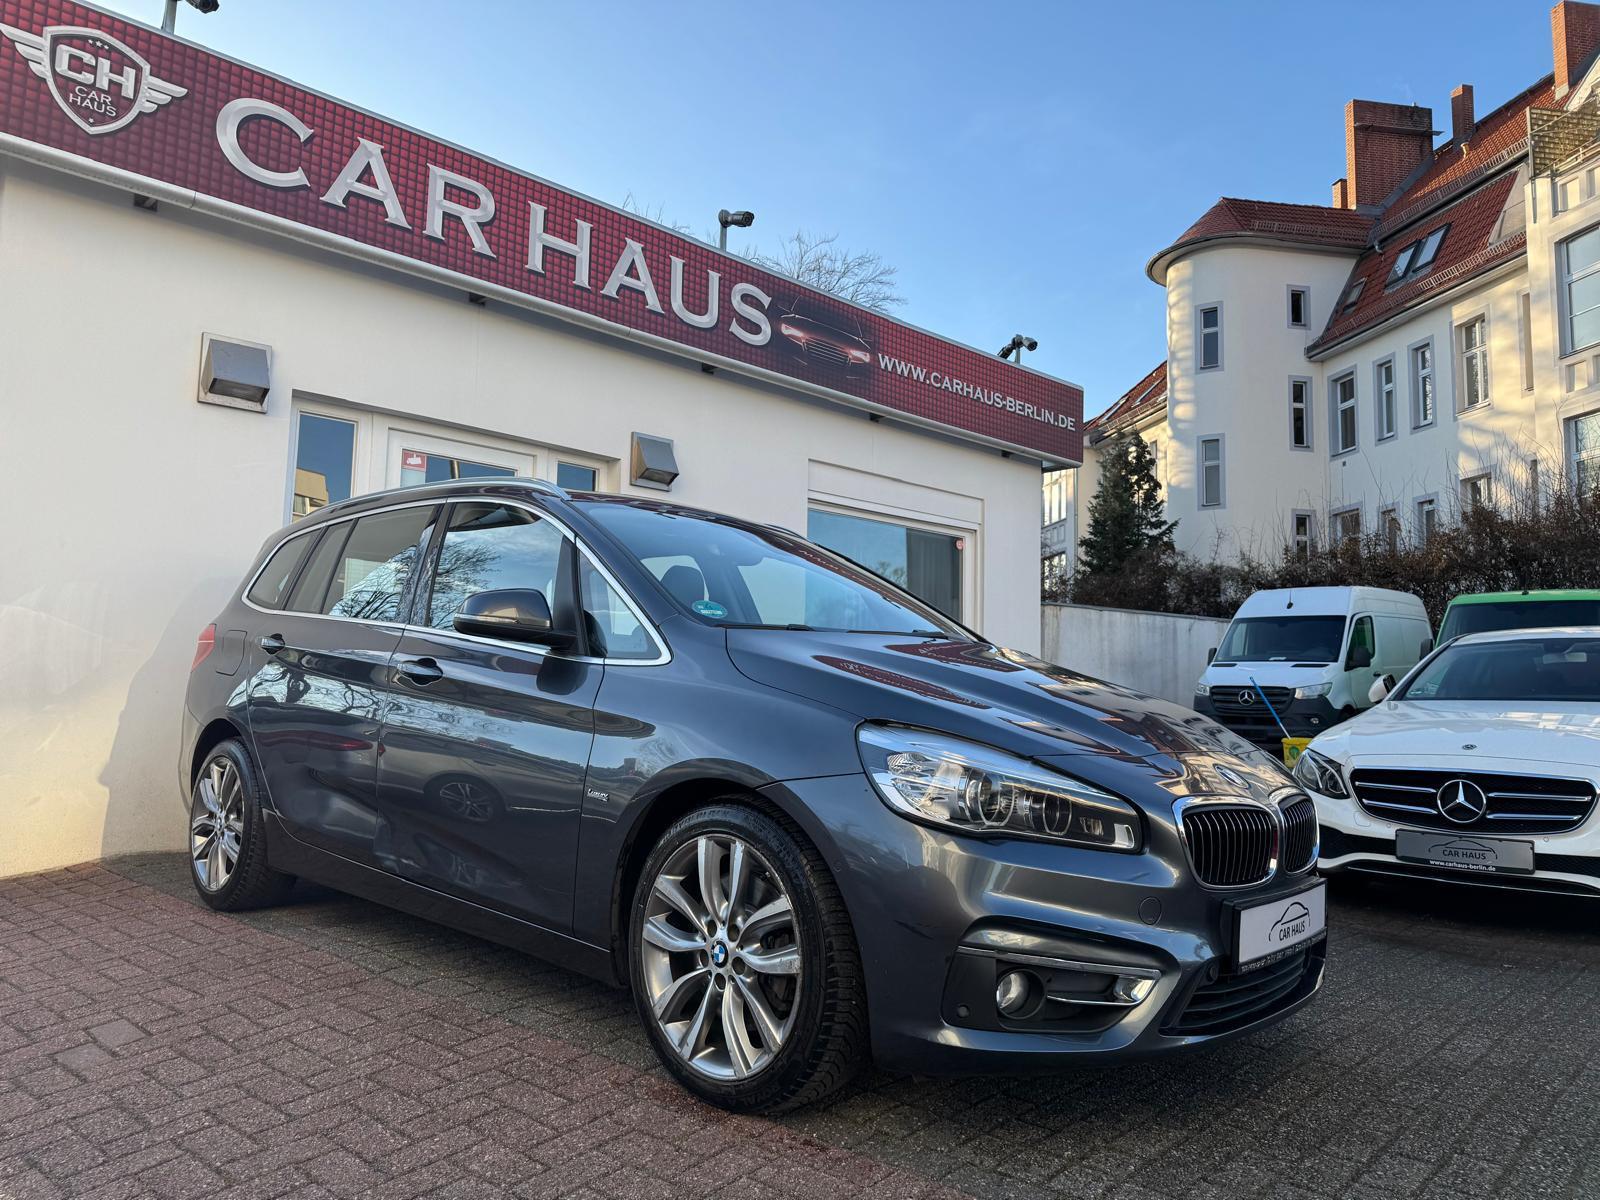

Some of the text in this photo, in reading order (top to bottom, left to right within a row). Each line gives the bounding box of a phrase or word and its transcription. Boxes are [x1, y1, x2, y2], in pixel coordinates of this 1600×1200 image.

[55, 44, 136, 99] CH
[69, 93, 117, 117] HAUS
[75, 86, 112, 105] CAR
[215, 98, 773, 346] CAR HAUS
[878, 353, 1076, 431] WWW.CARHAUS-BERLIN.DE
[1442, 849, 1487, 860] CAR HAUS
[1429, 860, 1496, 872] www.carhaus-berlin.de
[1279, 920, 1305, 941] CAR HAUS
